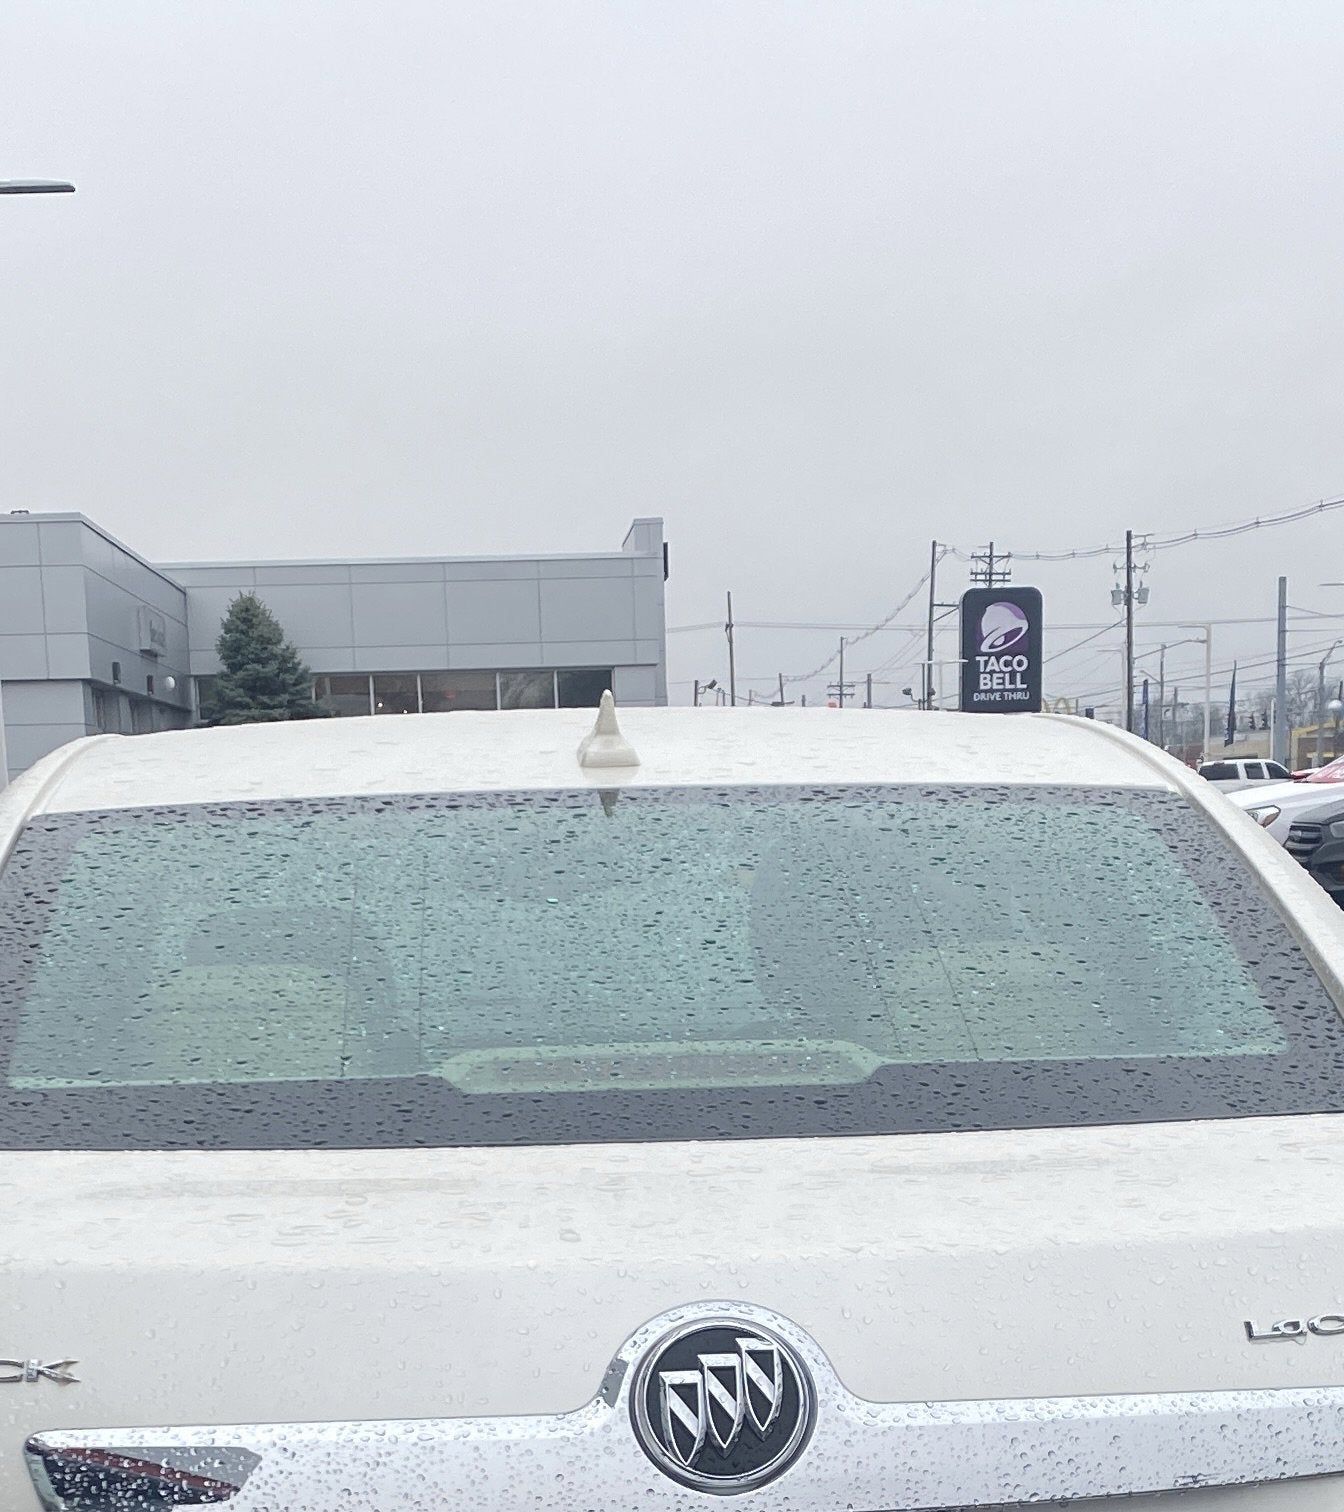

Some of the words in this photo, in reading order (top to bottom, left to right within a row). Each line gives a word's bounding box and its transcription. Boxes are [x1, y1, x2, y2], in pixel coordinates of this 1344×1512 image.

[975, 654, 1029, 673] TACO
[979, 672, 1027, 690] BELL
[973, 692, 1002, 702] DRIVE
[1003, 691, 1030, 700] THRU
